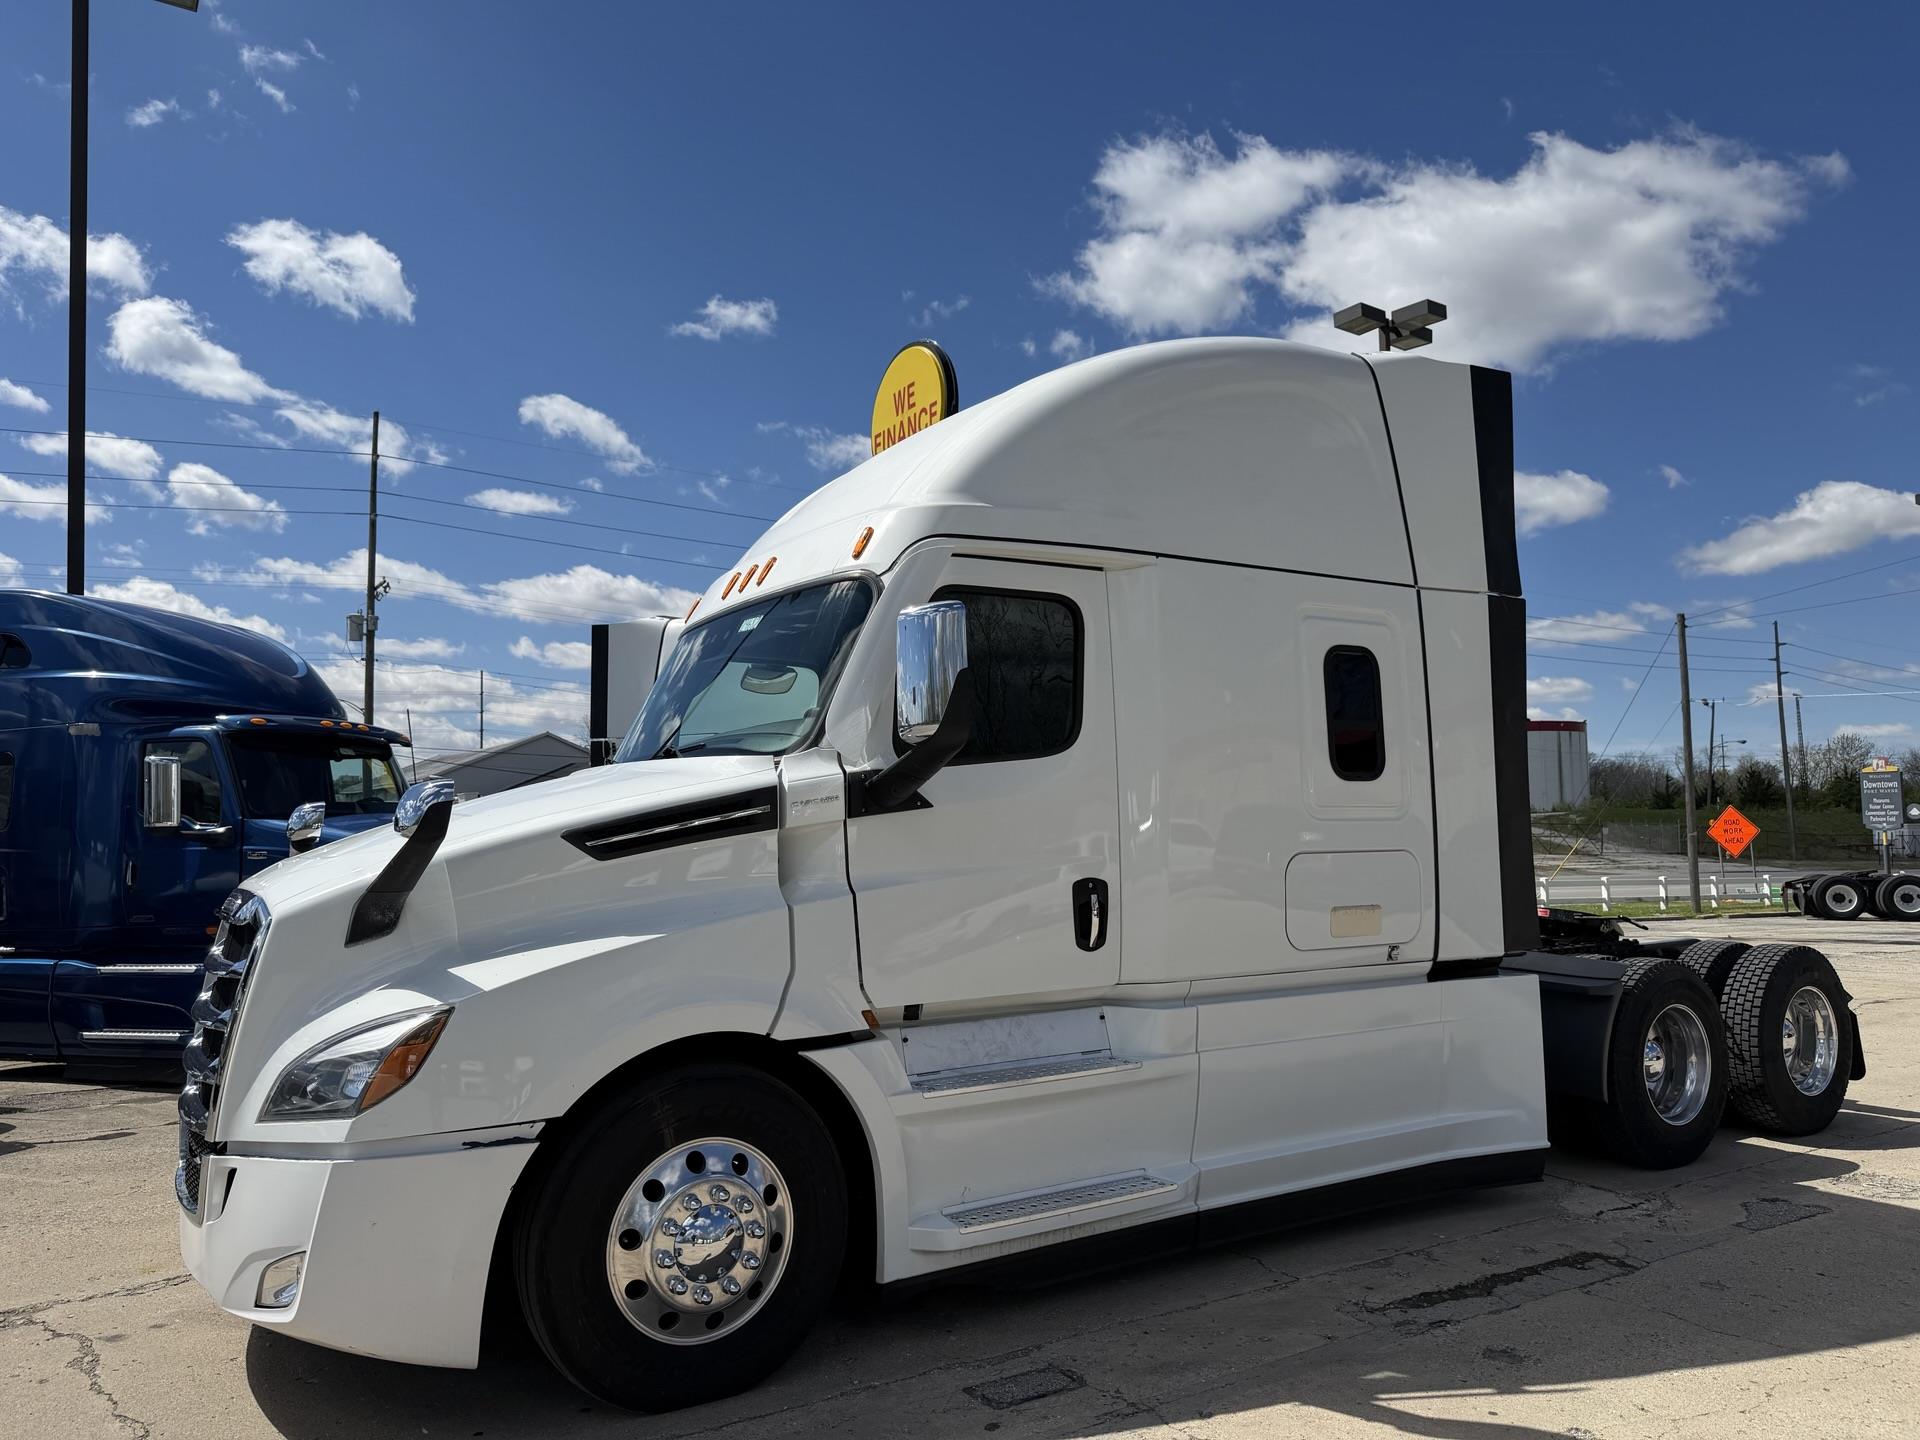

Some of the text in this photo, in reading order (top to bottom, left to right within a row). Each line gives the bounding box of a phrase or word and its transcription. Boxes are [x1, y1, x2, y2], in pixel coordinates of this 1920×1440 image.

[893, 381, 916, 417] WE
[874, 400, 938, 455] FINANCE
[1863, 780, 1898, 788] Downtown
